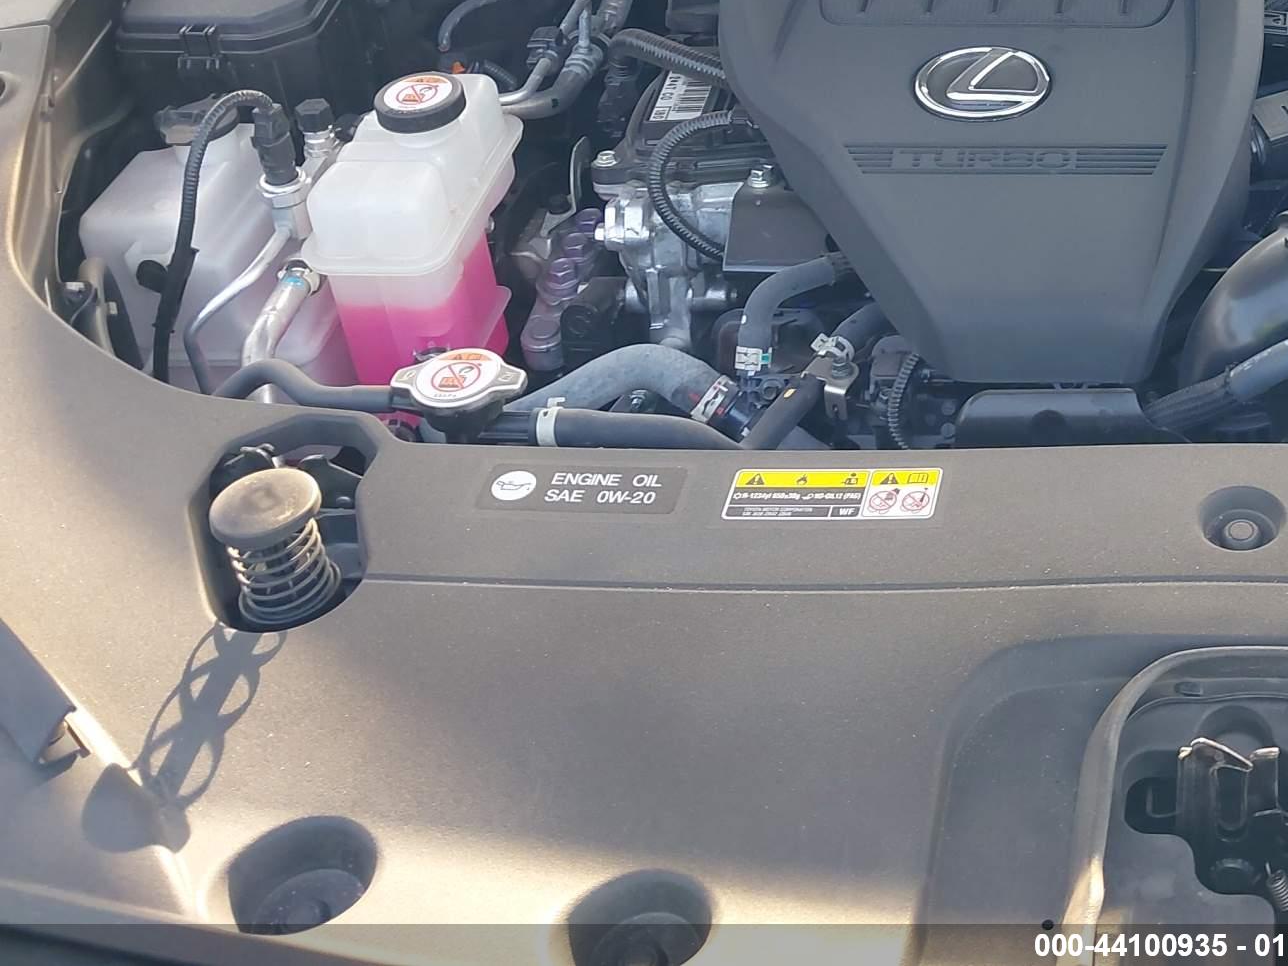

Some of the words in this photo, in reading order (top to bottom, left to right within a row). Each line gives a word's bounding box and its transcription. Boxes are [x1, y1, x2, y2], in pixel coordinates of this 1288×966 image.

[900, 149, 1070, 168] TURBO
[551, 472, 623, 487] ENGINE
[632, 474, 662, 487] OIL
[544, 489, 586, 502] SAE
[596, 490, 656, 504] 0W-20
[840, 508, 856, 516] WF
